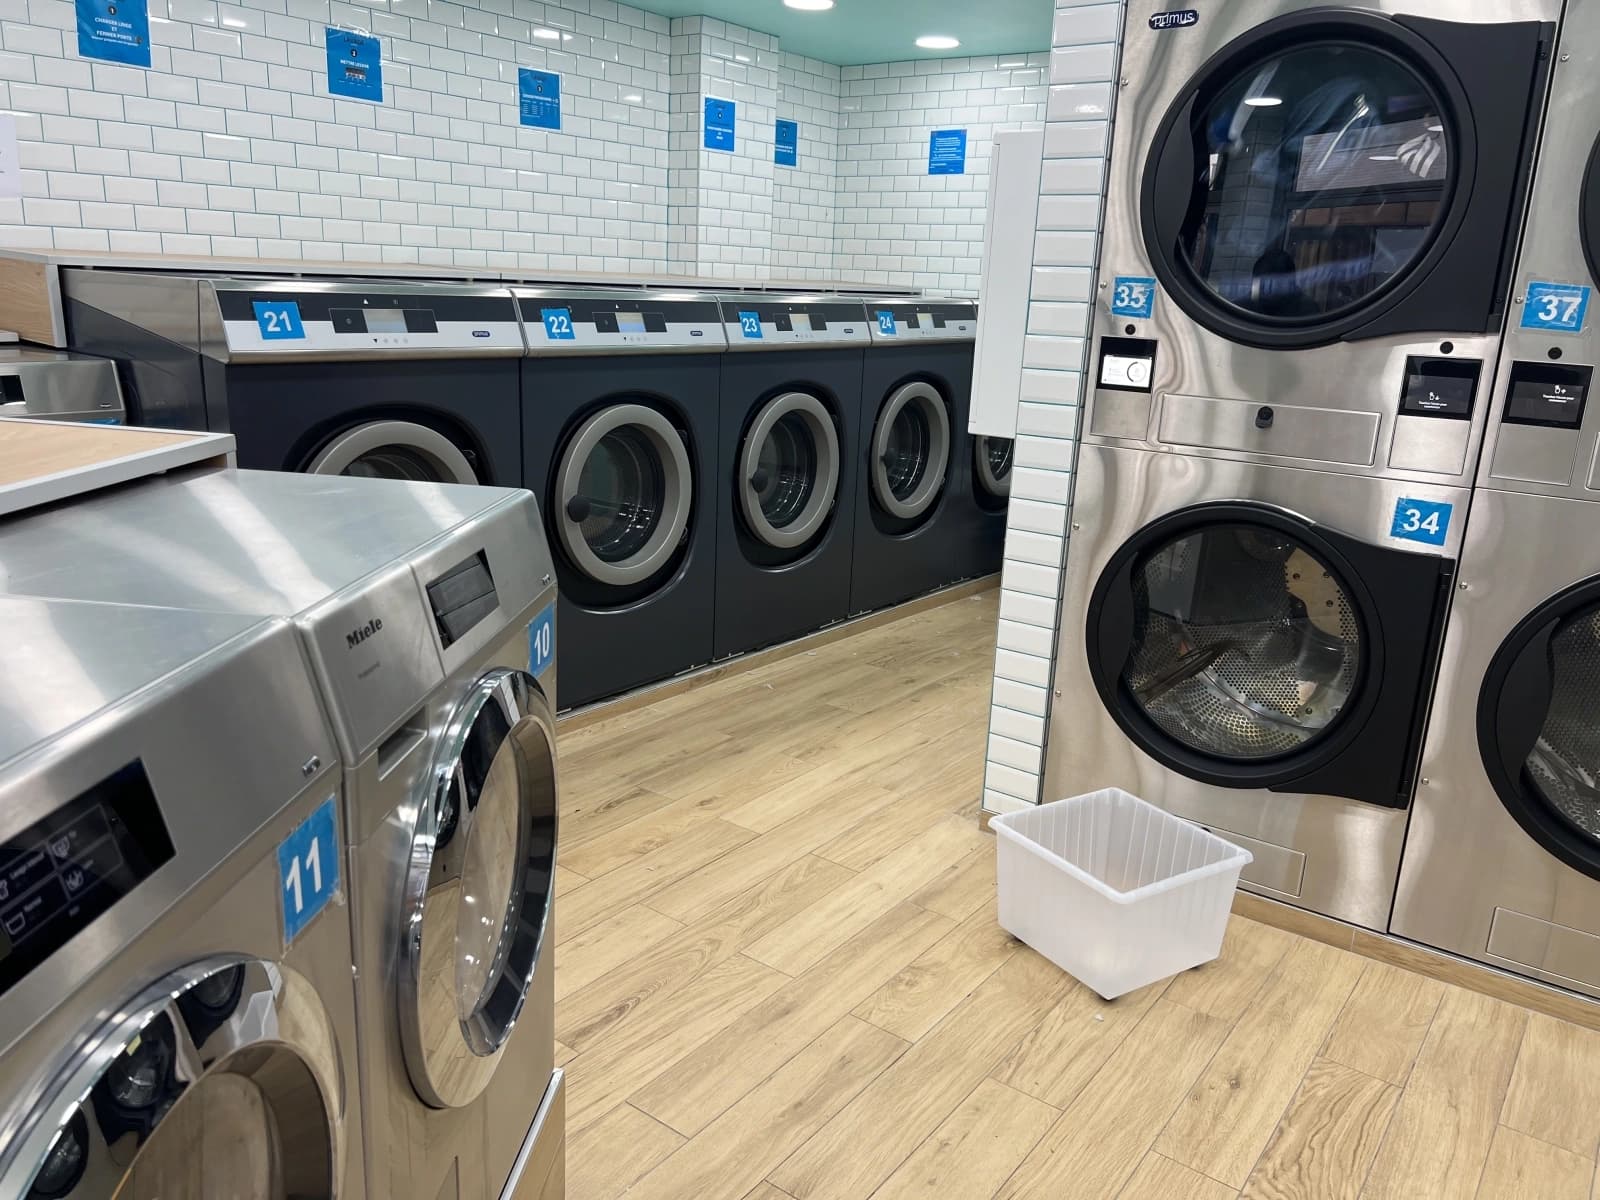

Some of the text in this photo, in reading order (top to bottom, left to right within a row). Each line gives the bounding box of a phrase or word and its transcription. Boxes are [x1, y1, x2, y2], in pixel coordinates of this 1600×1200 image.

[1153, 12, 1195, 28] primus
[1115, 285, 1147, 308] 35
[1537, 294, 1583, 322] 37
[263, 311, 293, 333] 21
[548, 316, 570, 333] 22
[742, 317, 758, 333] 23
[879, 316, 893, 329] 24
[1402, 508, 1440, 535] 34
[345, 618, 383, 650] Miele
[534, 621, 550, 666] 10
[286, 836, 322, 914] 11
